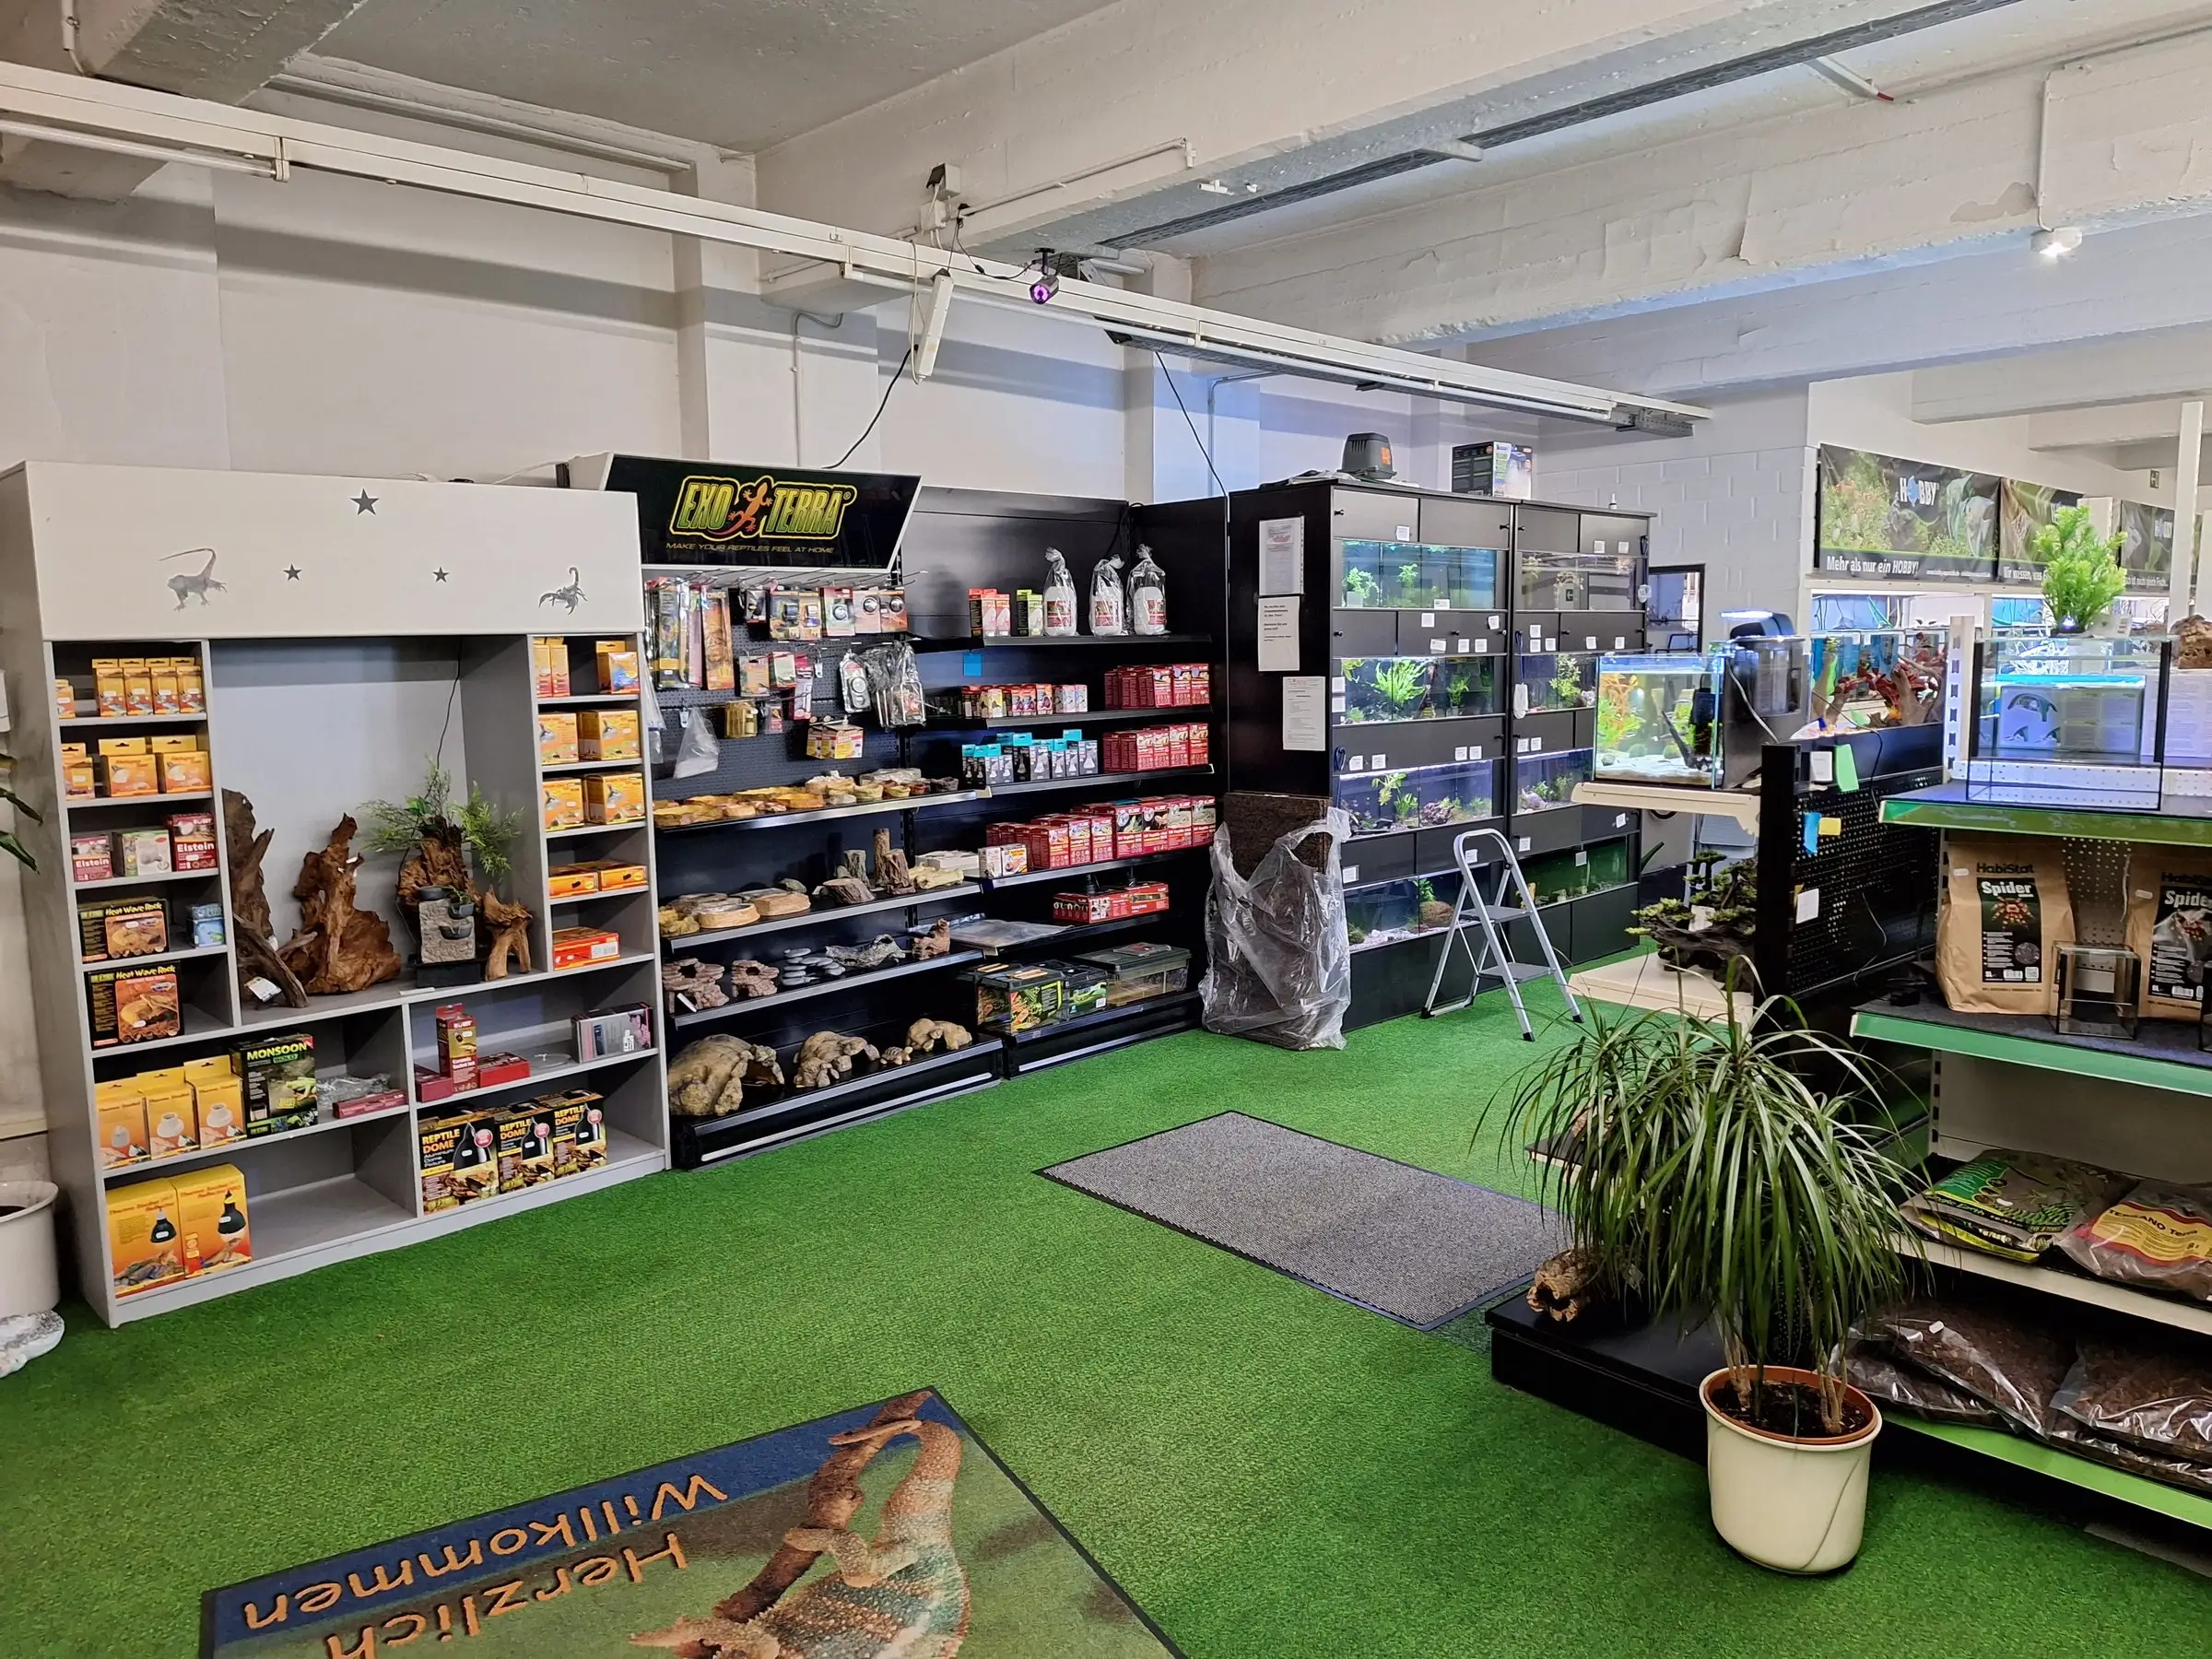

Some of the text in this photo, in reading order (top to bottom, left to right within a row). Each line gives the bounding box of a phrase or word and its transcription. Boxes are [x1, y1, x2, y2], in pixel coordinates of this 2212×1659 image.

[677, 482, 843, 535] EXO TERRA
[665, 542, 695, 550] MAKE
[699, 543, 725, 551] YOUR
[727, 544, 771, 553] REPTILES
[771, 546, 794, 554] FEEL
[1827, 555, 1850, 571] Mehr
[1851, 557, 1862, 572] als
[1863, 560, 1877, 573] nur
[1877, 559, 1891, 573] ein
[1976, 862, 2035, 874] HabiStat
[1981, 881, 2031, 896] Spider
[105, 907, 123, 916] Heat
[124, 905, 145, 914] Wave
[145, 902, 162, 912] Rock
[115, 971, 135, 980] Heat
[135, 968, 157, 978] Wave
[157, 965, 176, 975] Rock
[246, 1042, 308, 1061] MONSOON
[554, 1105, 584, 1119] REPTILE
[500, 1118, 532, 1133] REPTILE
[555, 1114, 580, 1126] DOME
[421, 1128, 461, 1146] REPTILE
[500, 1127, 526, 1140] DOME
[422, 1140, 454, 1154] DOME
[243, 1474, 728, 1630] Willkommen
[327, 1532, 688, 1659] Herzlich
